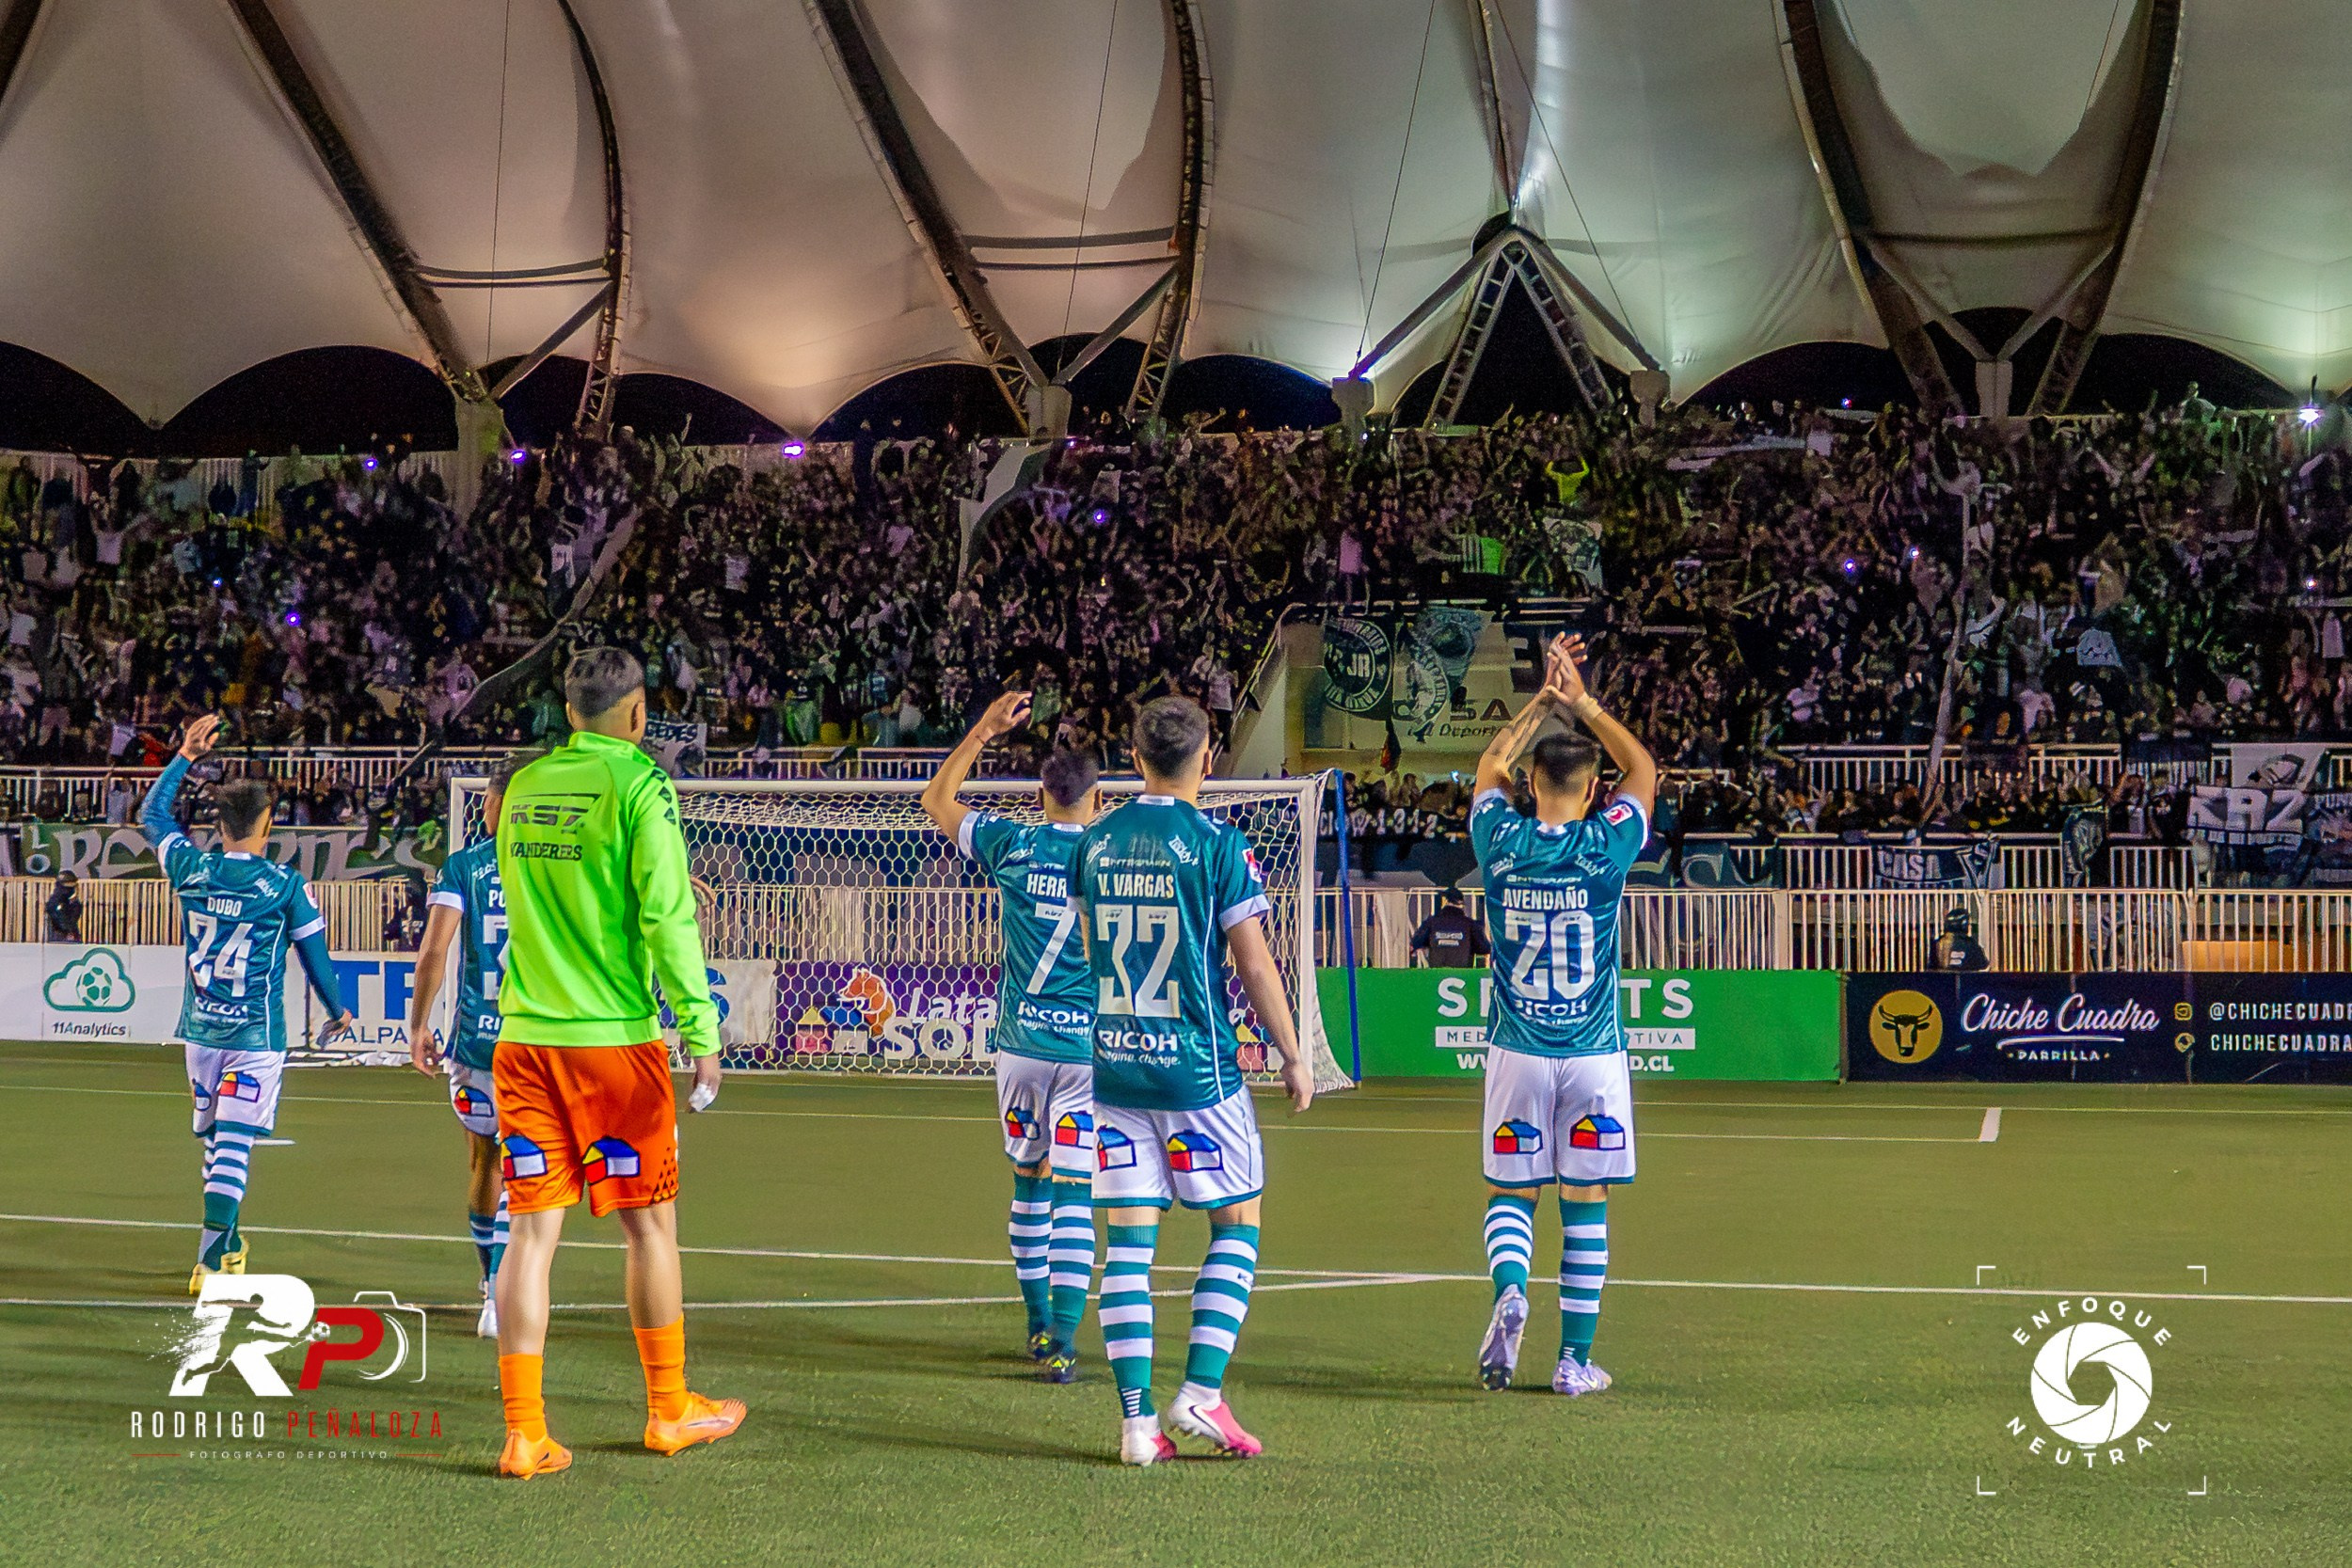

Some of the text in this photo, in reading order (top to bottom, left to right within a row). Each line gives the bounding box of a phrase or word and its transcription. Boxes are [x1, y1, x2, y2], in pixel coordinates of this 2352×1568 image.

[1097, 873, 1174, 898] V. VARGAS
[1502, 886, 1589, 910] AVENDAÑO
[188, 911, 254, 997] 24
[1025, 902, 1079, 995] 7
[1094, 904, 1181, 1018] 32
[1504, 909, 1596, 1000] 20
[1961, 992, 2161, 1032] Chiche Cuadra
[53, 1022, 126, 1037] 11Analytics
[1099, 1030, 1178, 1053] RICOH
[2018, 1050, 2100, 1061] PARRILLA
